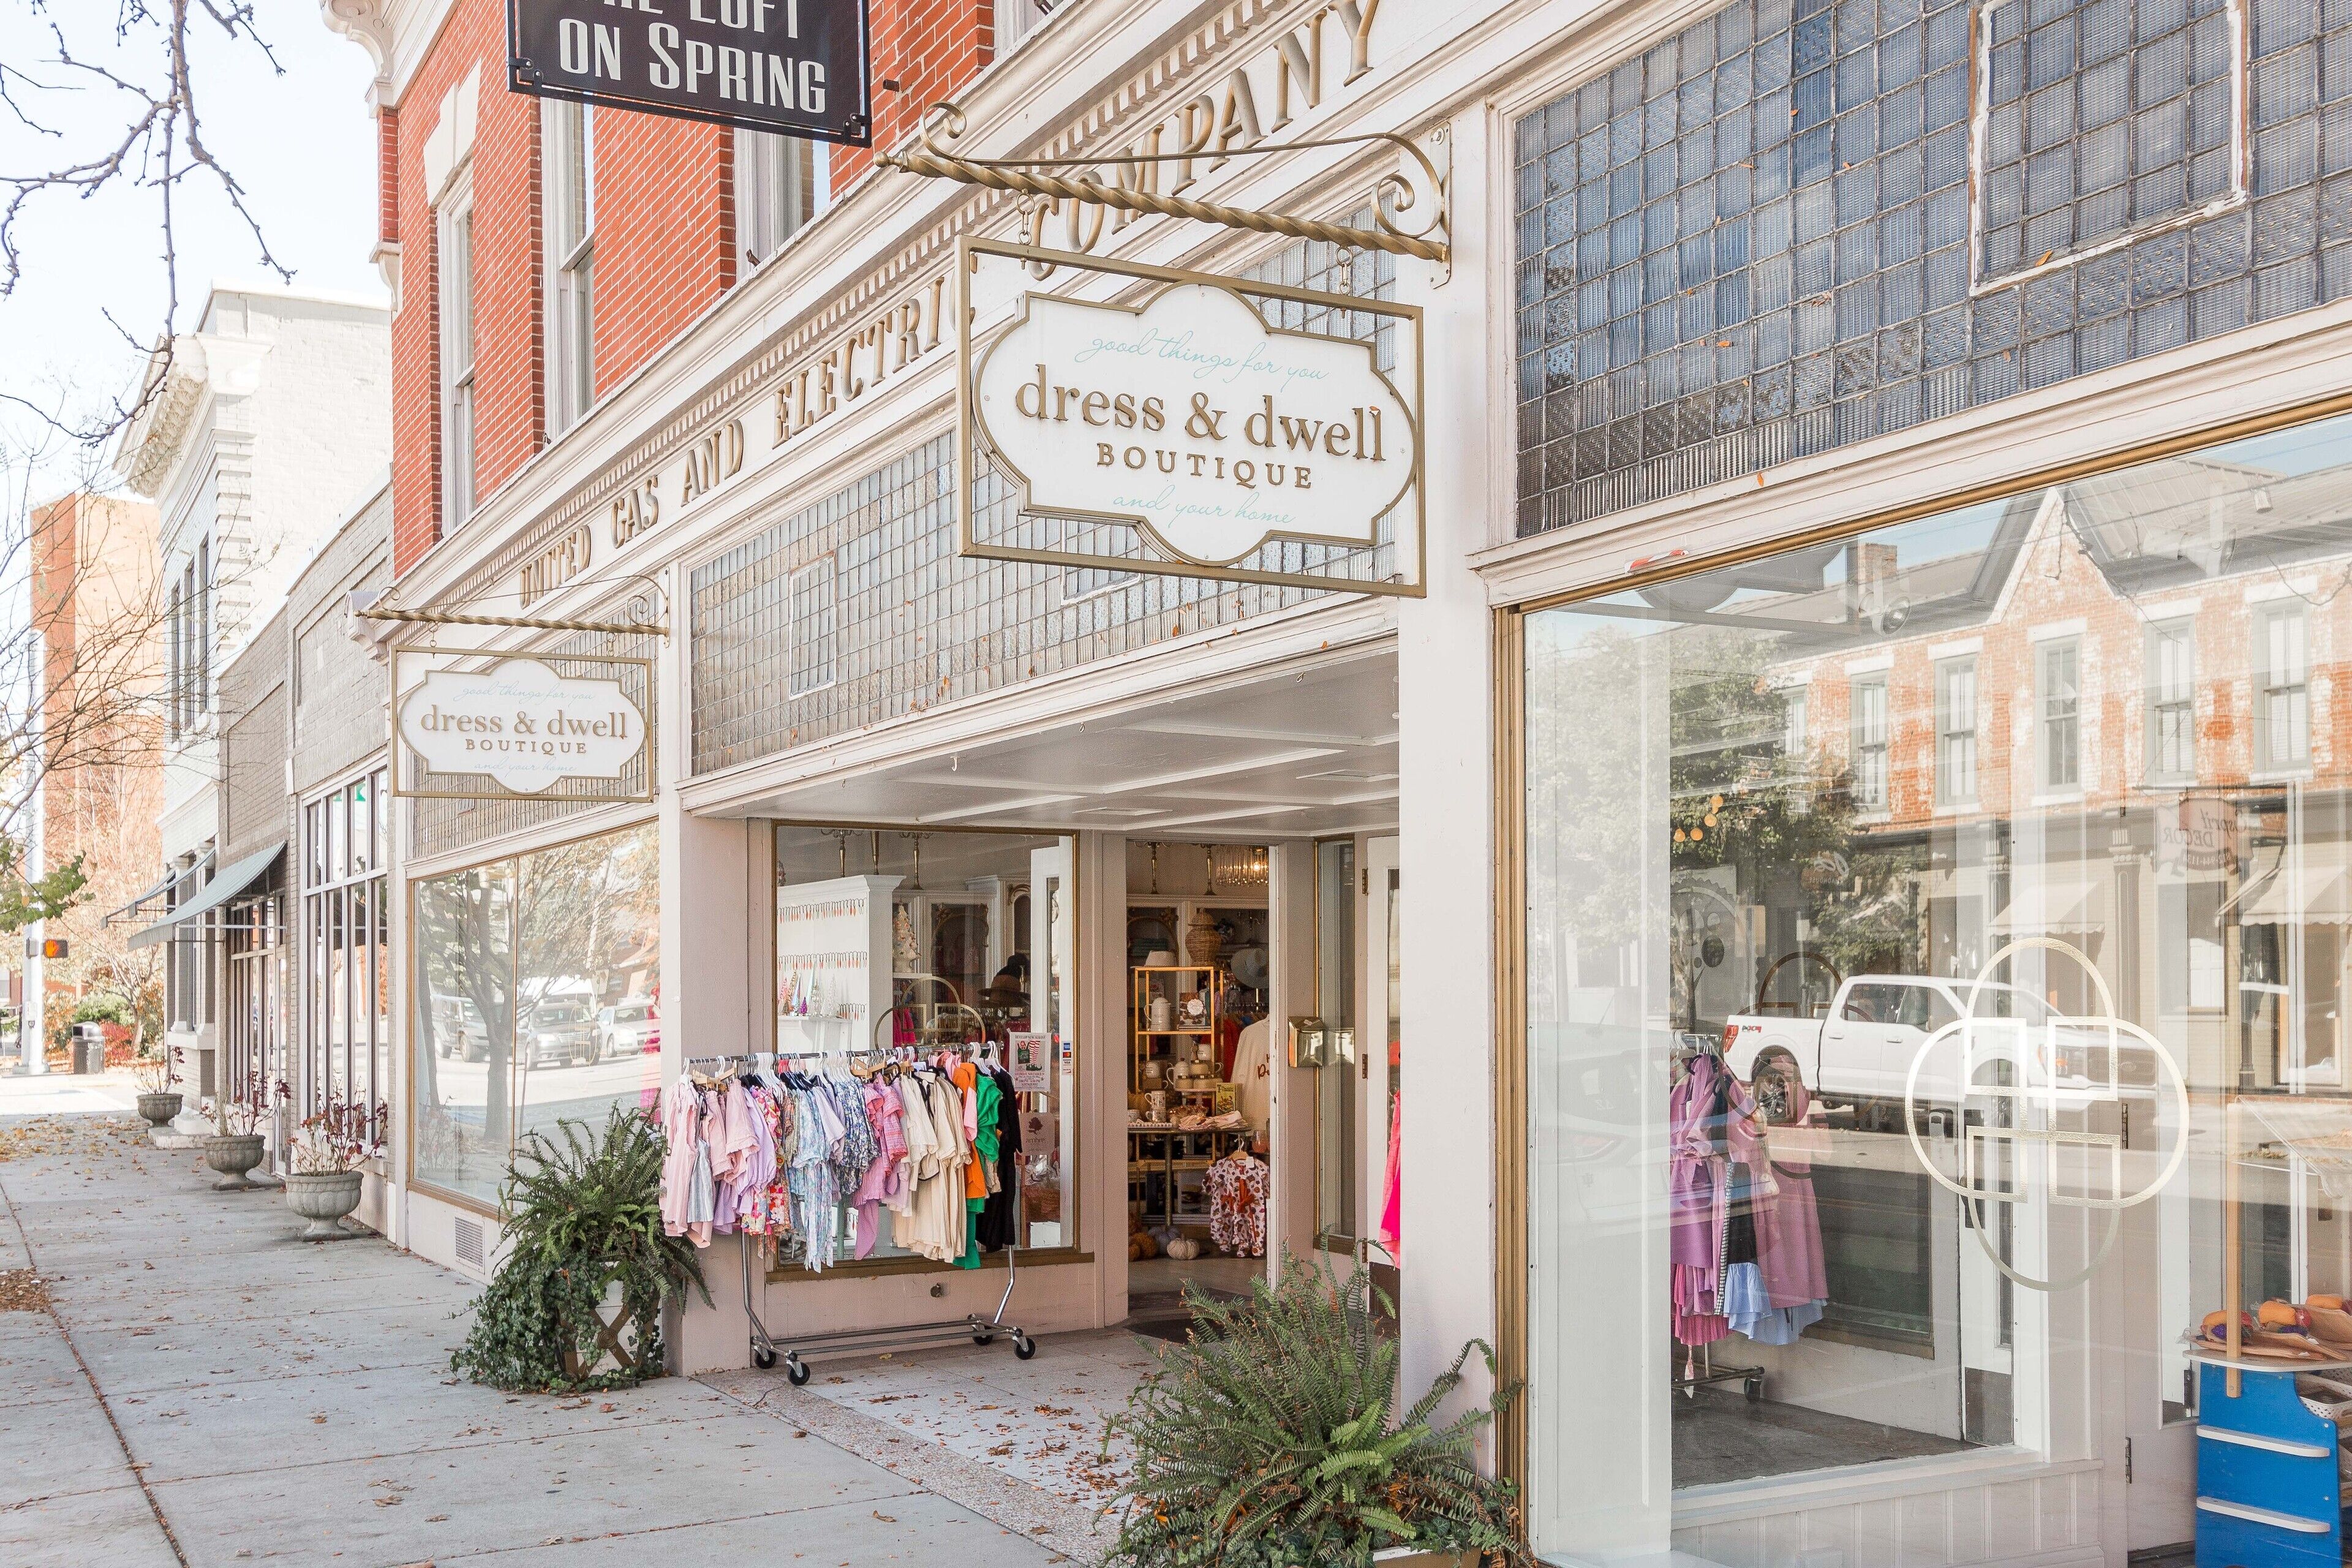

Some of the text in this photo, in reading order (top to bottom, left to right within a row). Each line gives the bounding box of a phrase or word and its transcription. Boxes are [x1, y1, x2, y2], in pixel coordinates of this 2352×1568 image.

[559, 18, 826, 114] ON SPRING
[1074, 328, 1329, 393] good things for you
[1016, 364, 1386, 462] dress & dwell
[1097, 442, 1312, 489] BOUTIQUE
[520, 525, 591, 609] UNITED
[611, 475, 659, 549] GAS
[681, 419, 744, 507] AND
[1113, 485, 1296, 529] and your home
[453, 681, 595, 707] good things for you
[421, 705, 628, 740] dress & dwell
[466, 739, 587, 755] BOUTIQUE
[475, 756, 577, 778] and your home
